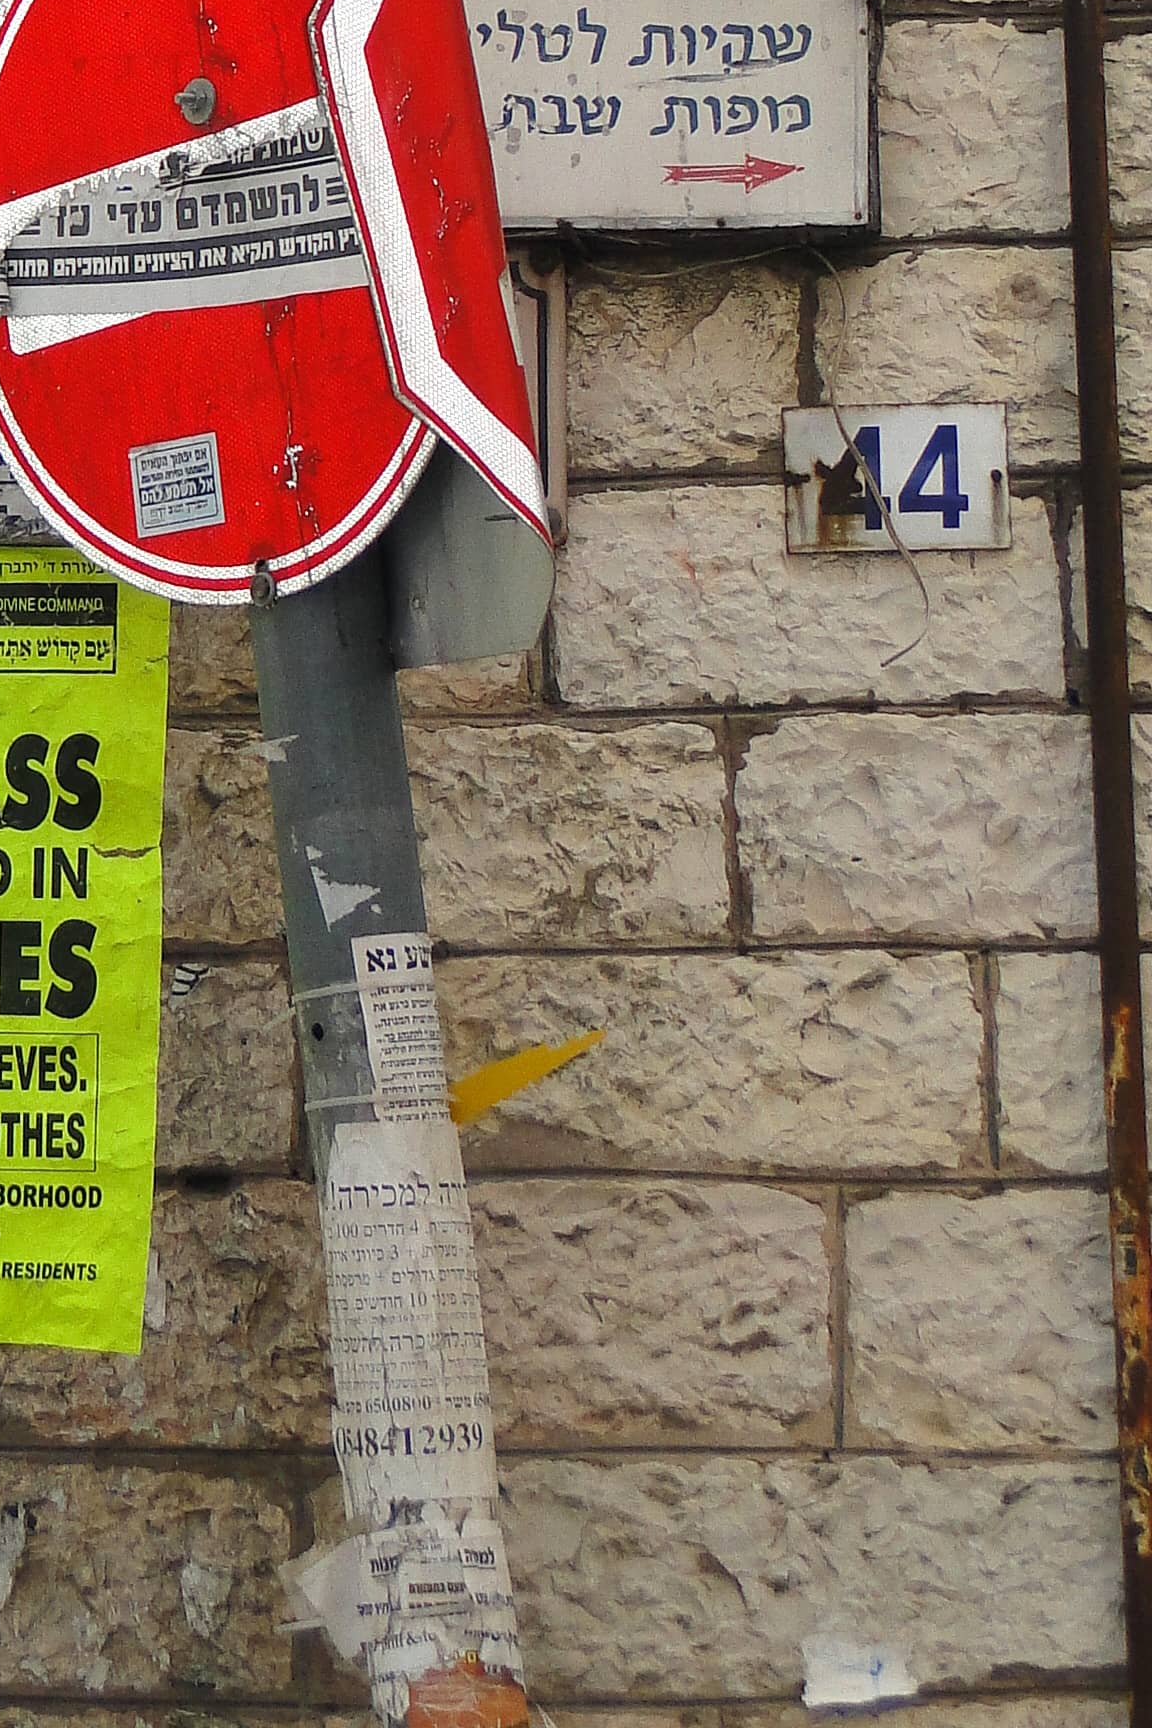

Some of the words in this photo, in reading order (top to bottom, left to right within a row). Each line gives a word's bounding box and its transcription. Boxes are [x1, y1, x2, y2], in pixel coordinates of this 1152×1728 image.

[468, 7, 607, 65] לטלי
[627, 22, 813, 75] שקיות
[500, 92, 622, 137] שבת
[650, 93, 812, 138] מפות
[107, 199, 162, 234] עדי
[175, 173, 321, 231] להשמדם
[231, 238, 275, 266] תקיא
[279, 230, 335, 257] הקודש
[337, 226, 360, 252] רץ
[7, 257, 48, 279] מתוכ
[199, 245, 228, 269] את
[38, 597, 104, 613] COMMAND
[33, 846, 89, 900] IN
[2, 1261, 97, 1281] RESIDENTS
